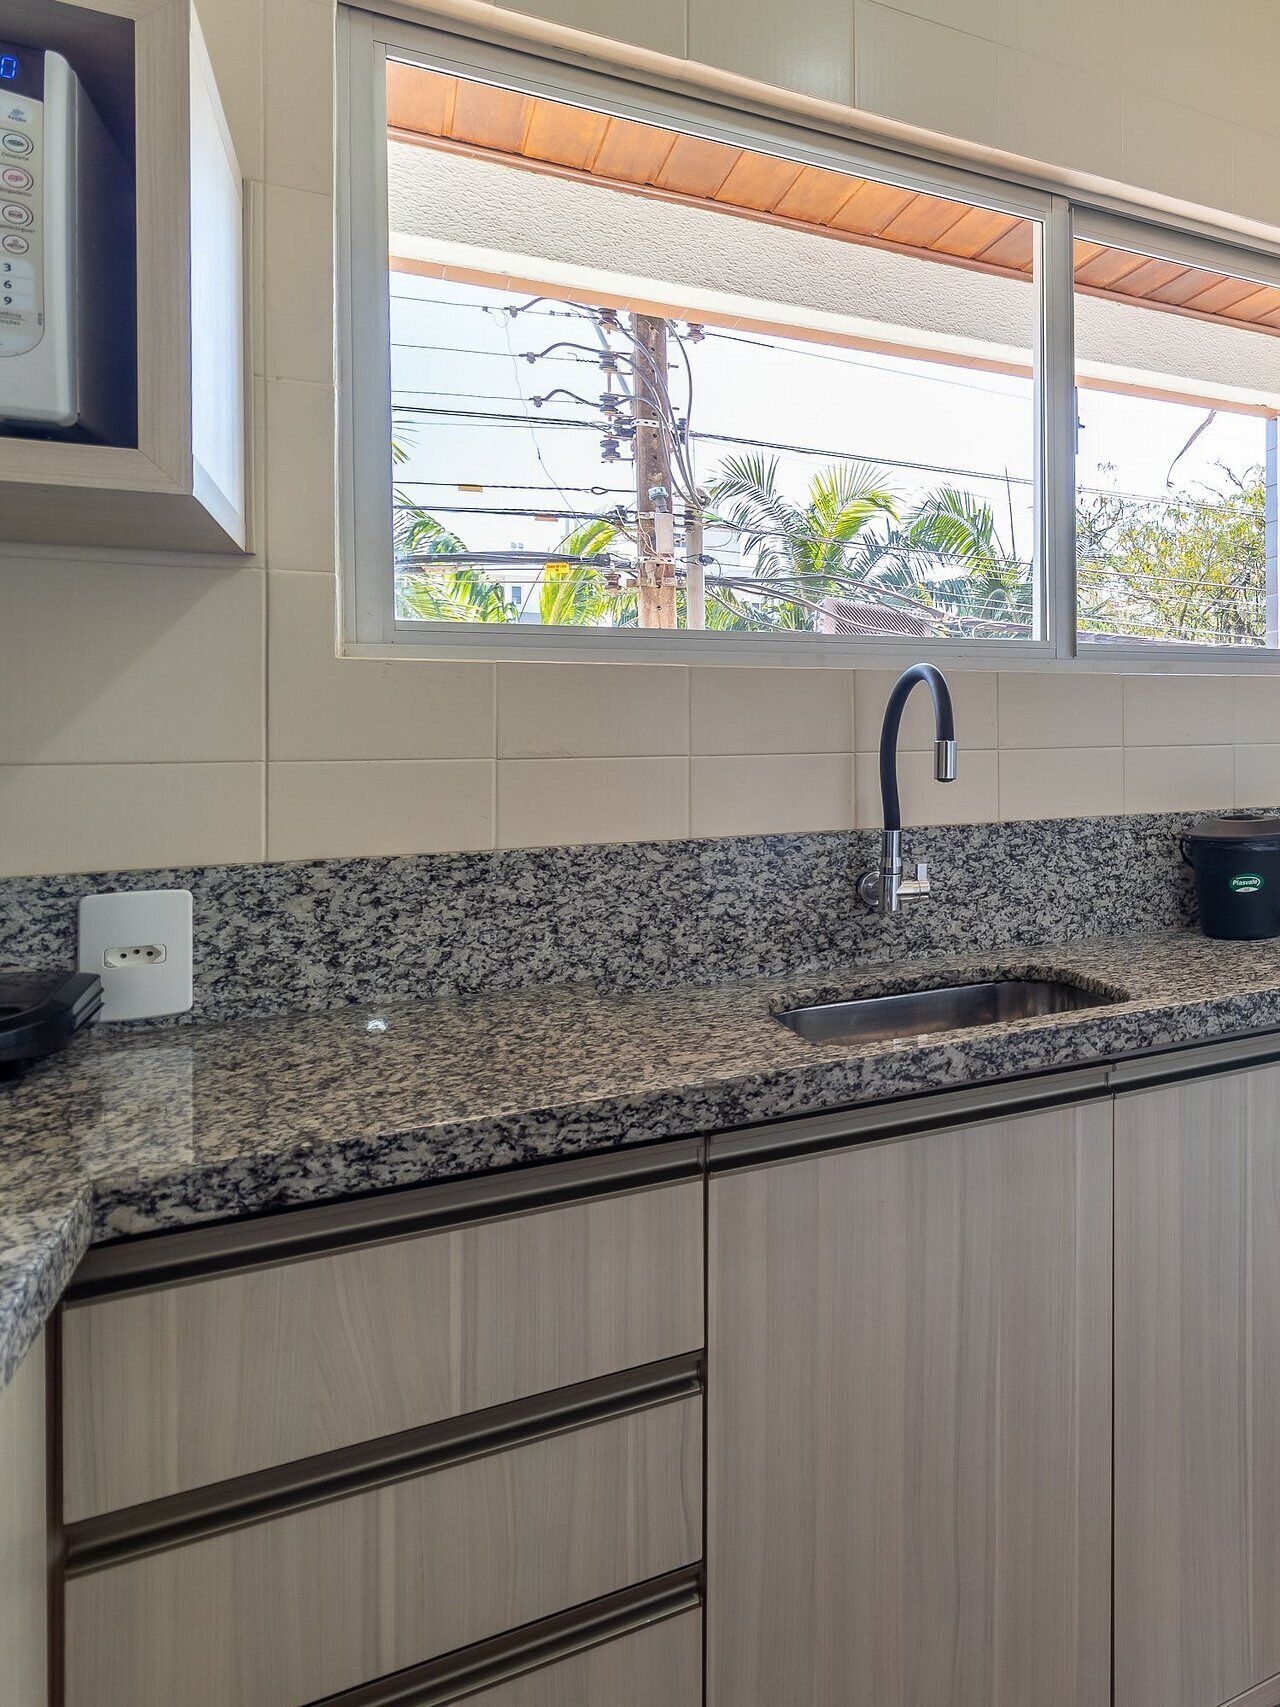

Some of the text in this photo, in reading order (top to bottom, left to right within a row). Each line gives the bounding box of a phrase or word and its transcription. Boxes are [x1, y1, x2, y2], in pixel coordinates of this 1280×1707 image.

[3, 263, 12, 272] 3
[3, 280, 12, 289] 6
[3, 296, 12, 305] 9
